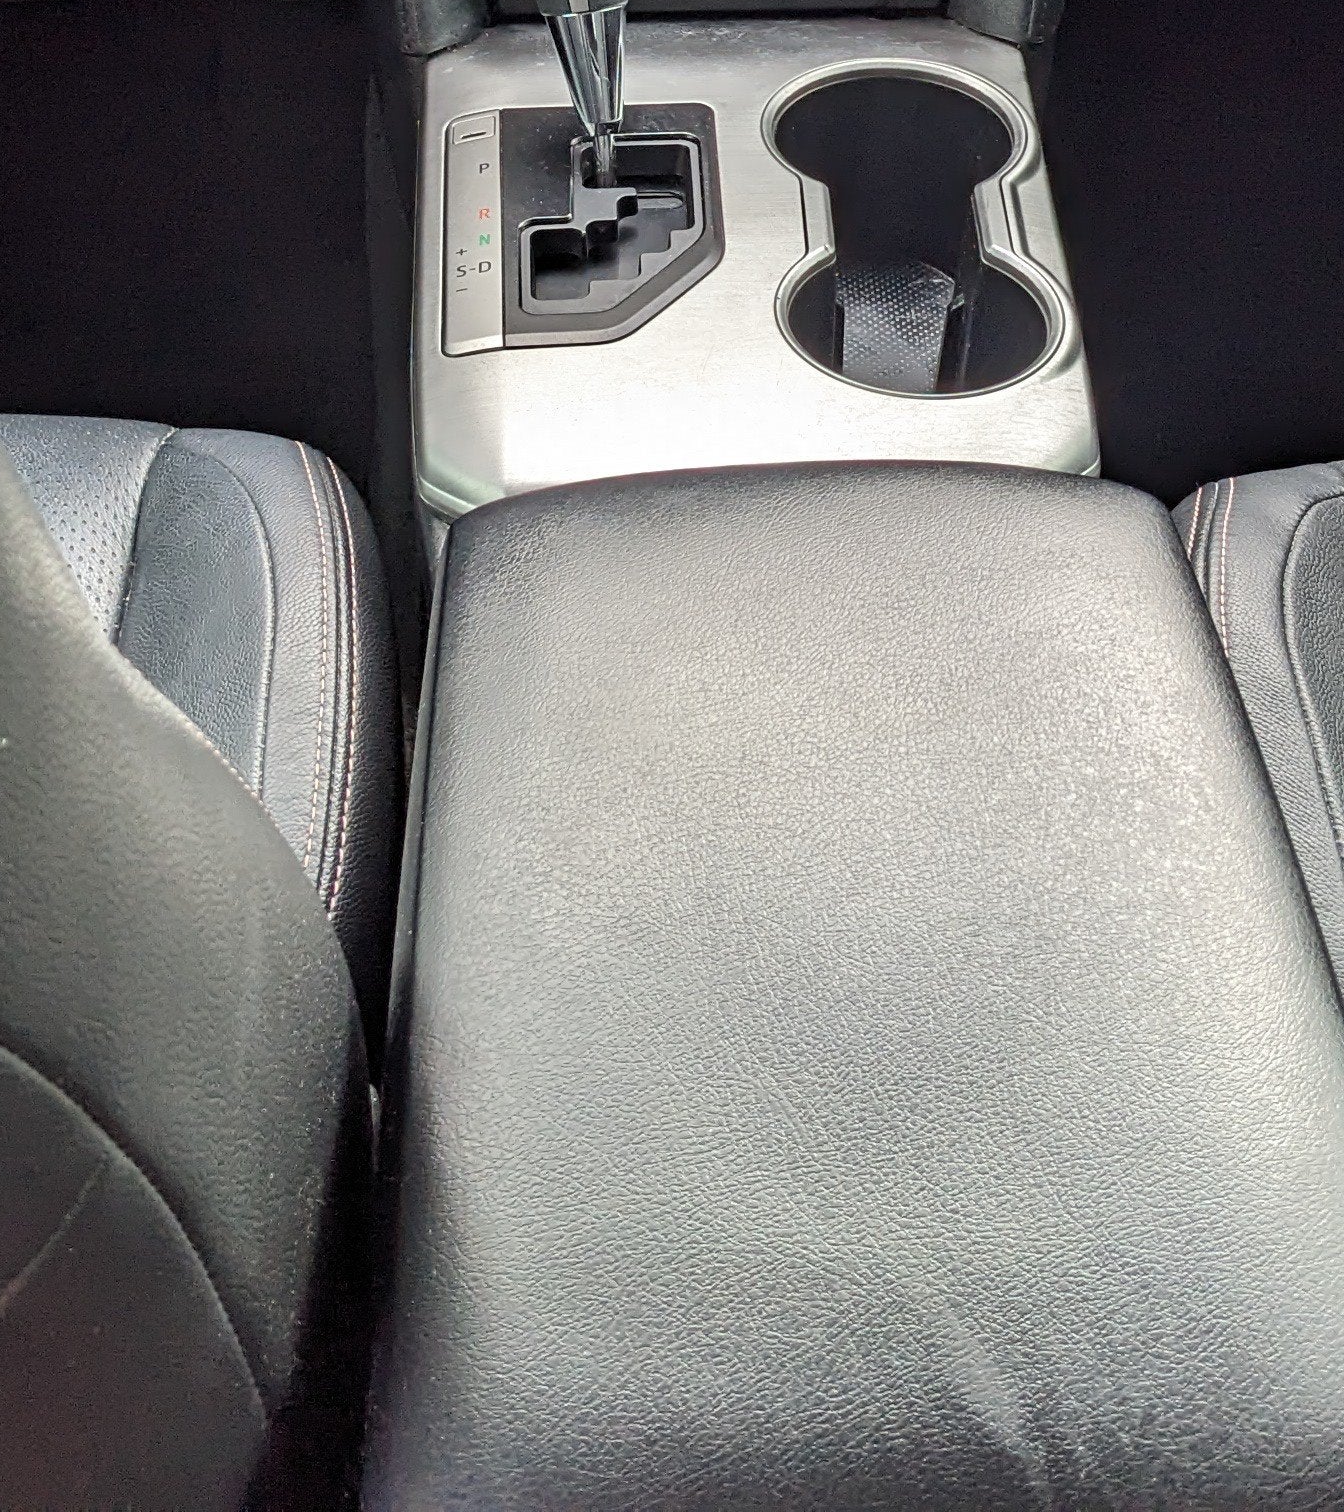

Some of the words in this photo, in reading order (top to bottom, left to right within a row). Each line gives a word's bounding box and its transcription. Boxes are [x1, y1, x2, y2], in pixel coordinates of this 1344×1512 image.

[479, 163, 490, 174] P
[479, 208, 490, 220] R
[479, 234, 491, 246] N
